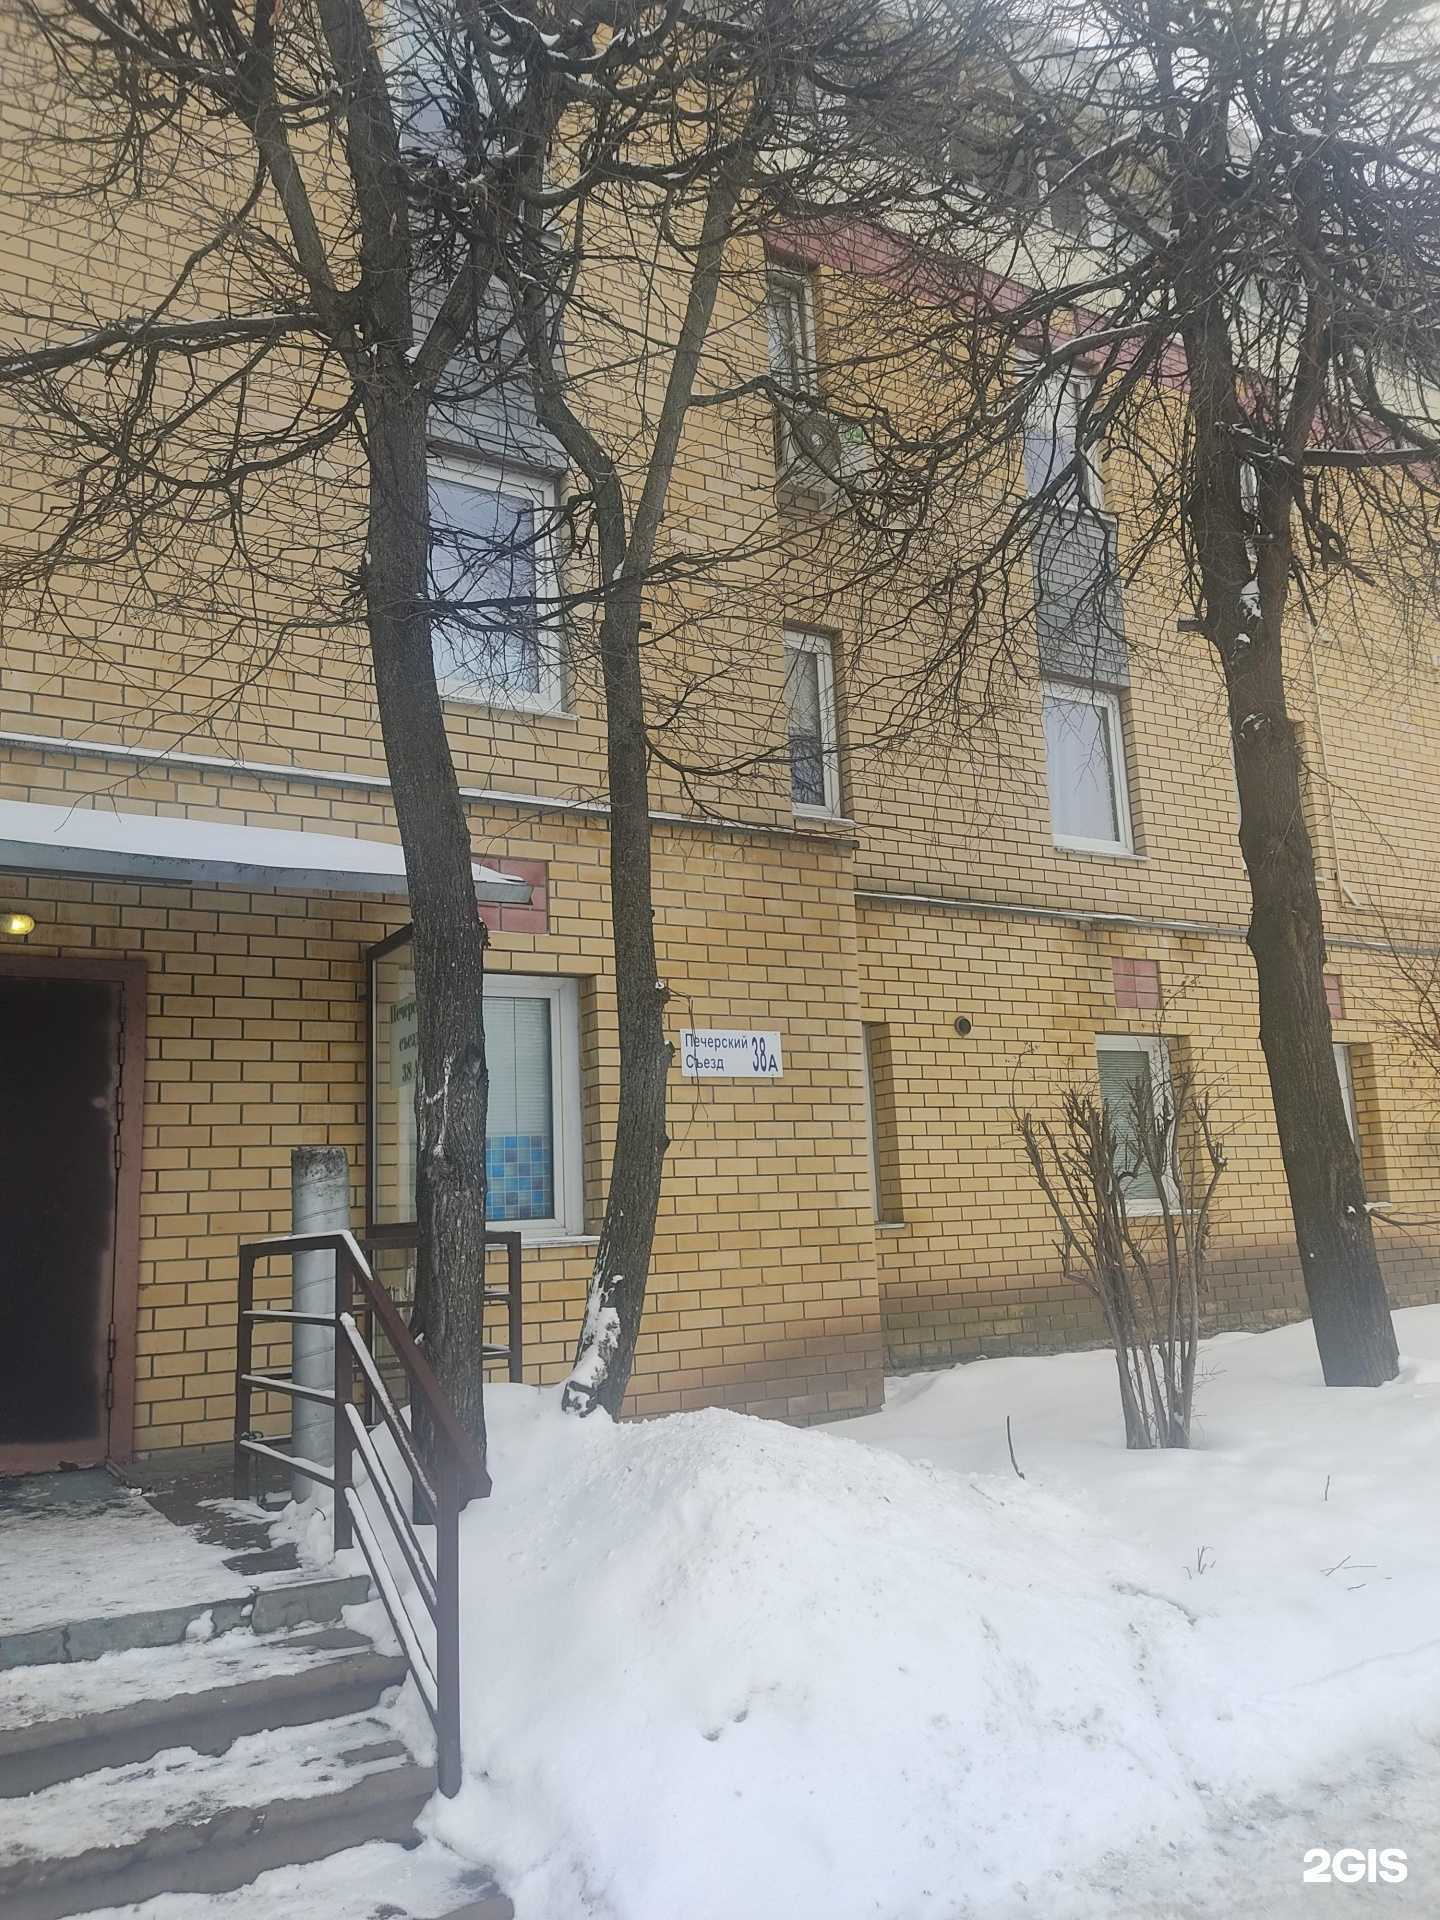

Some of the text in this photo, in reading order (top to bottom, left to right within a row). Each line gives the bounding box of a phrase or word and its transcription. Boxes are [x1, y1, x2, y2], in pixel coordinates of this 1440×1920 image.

[685, 1033, 748, 1051] Печерский
[685, 1054, 724, 1071] Съезд
[751, 1036, 778, 1072] 38А
